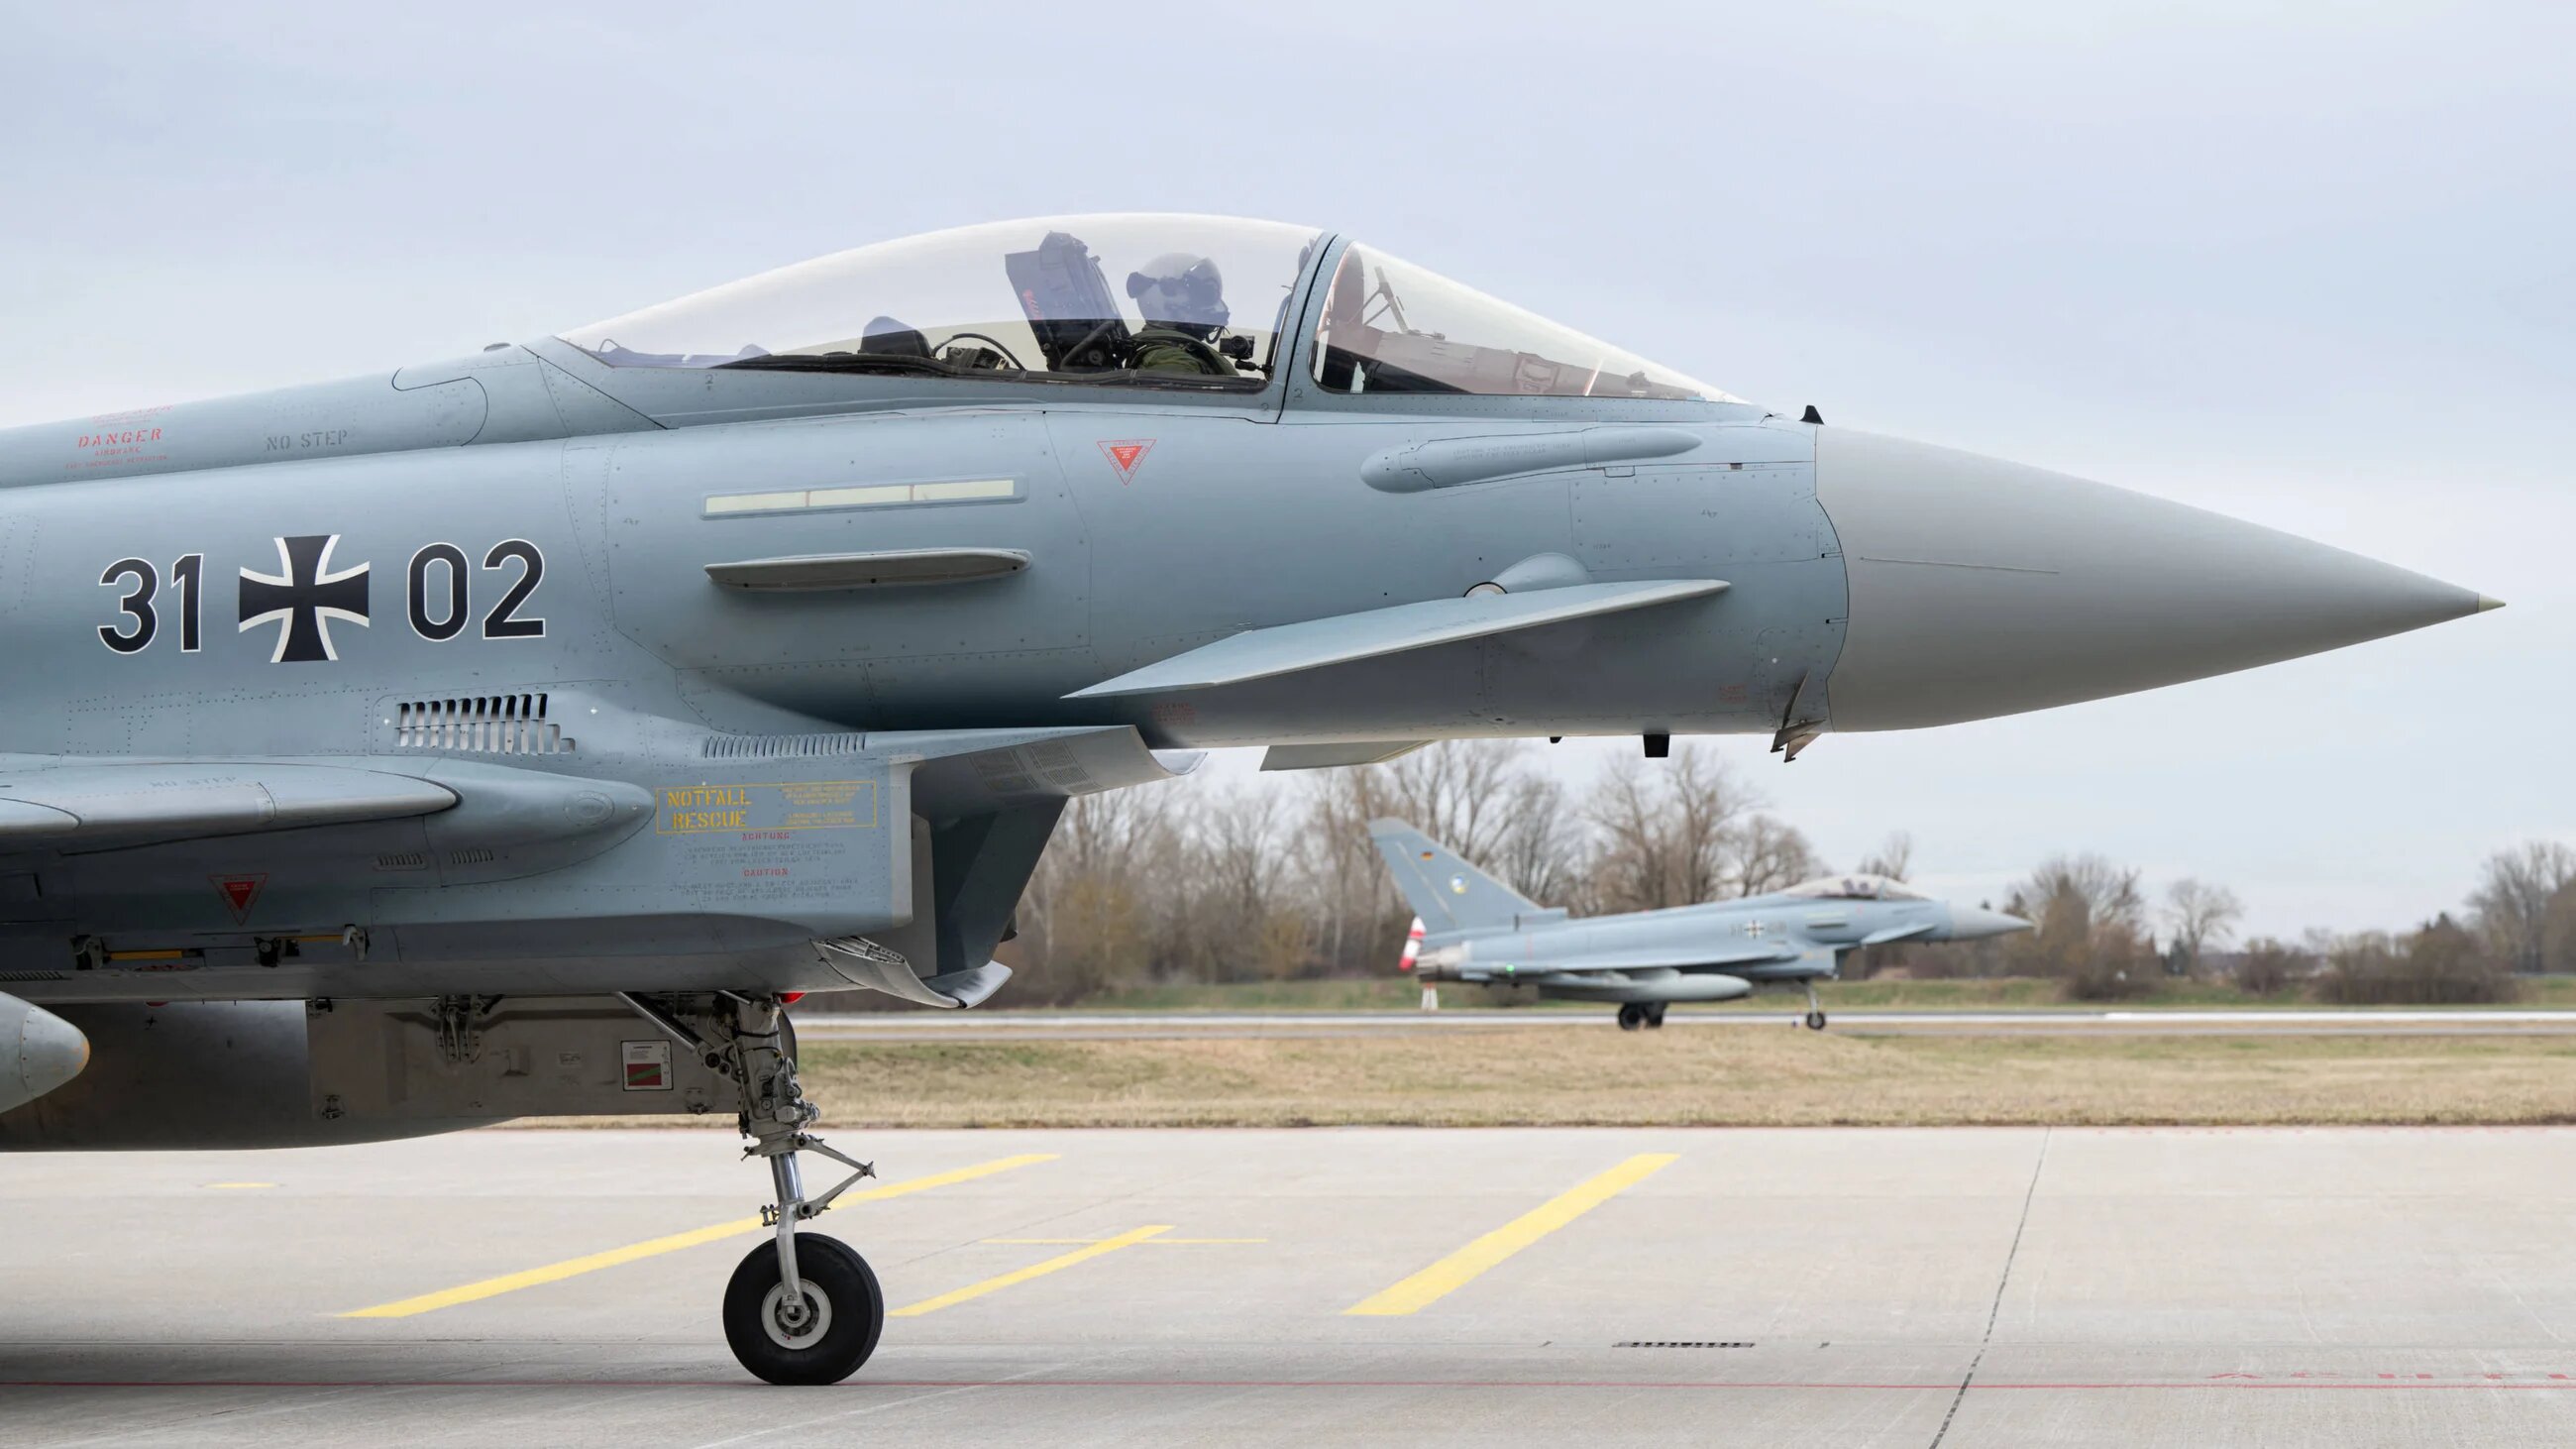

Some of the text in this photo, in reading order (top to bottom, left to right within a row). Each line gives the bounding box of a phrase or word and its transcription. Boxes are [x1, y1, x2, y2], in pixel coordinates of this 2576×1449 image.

[77, 427, 163, 449] DANGER
[266, 428, 348, 452] NO STEP
[96, 537, 546, 655] 31 02
[667, 787, 752, 808] NOTFALL
[672, 810, 748, 830] RESCUE
[741, 832, 791, 840] ACHTUNG
[743, 867, 790, 877] CAUTION
